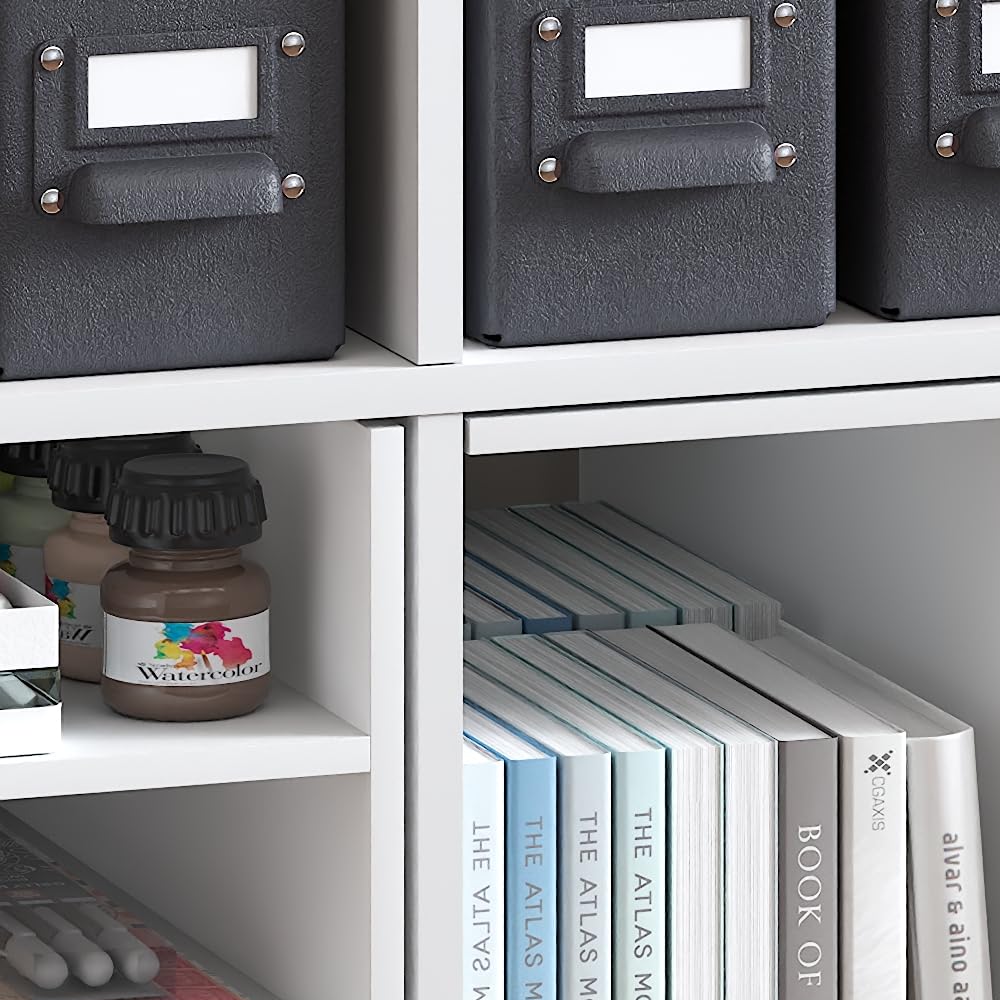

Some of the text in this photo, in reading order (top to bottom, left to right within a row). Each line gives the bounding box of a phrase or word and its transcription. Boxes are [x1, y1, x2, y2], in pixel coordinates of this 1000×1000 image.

[136, 661, 263, 682] Watercolor
[871, 776, 886, 832] CGAXIS
[524, 816, 544, 867] THE
[579, 811, 598, 863] THE
[634, 807, 653, 859] THE
[797, 824, 822, 926] BOOK
[942, 832, 965, 893] alvar
[524, 882, 544, 968] ATLAS
[579, 877, 598, 964] ATLAS
[634, 873, 653, 959] ATLAS
[947, 901, 963, 914] &
[797, 941, 822, 987] OF
[948, 923, 972, 973] aino
